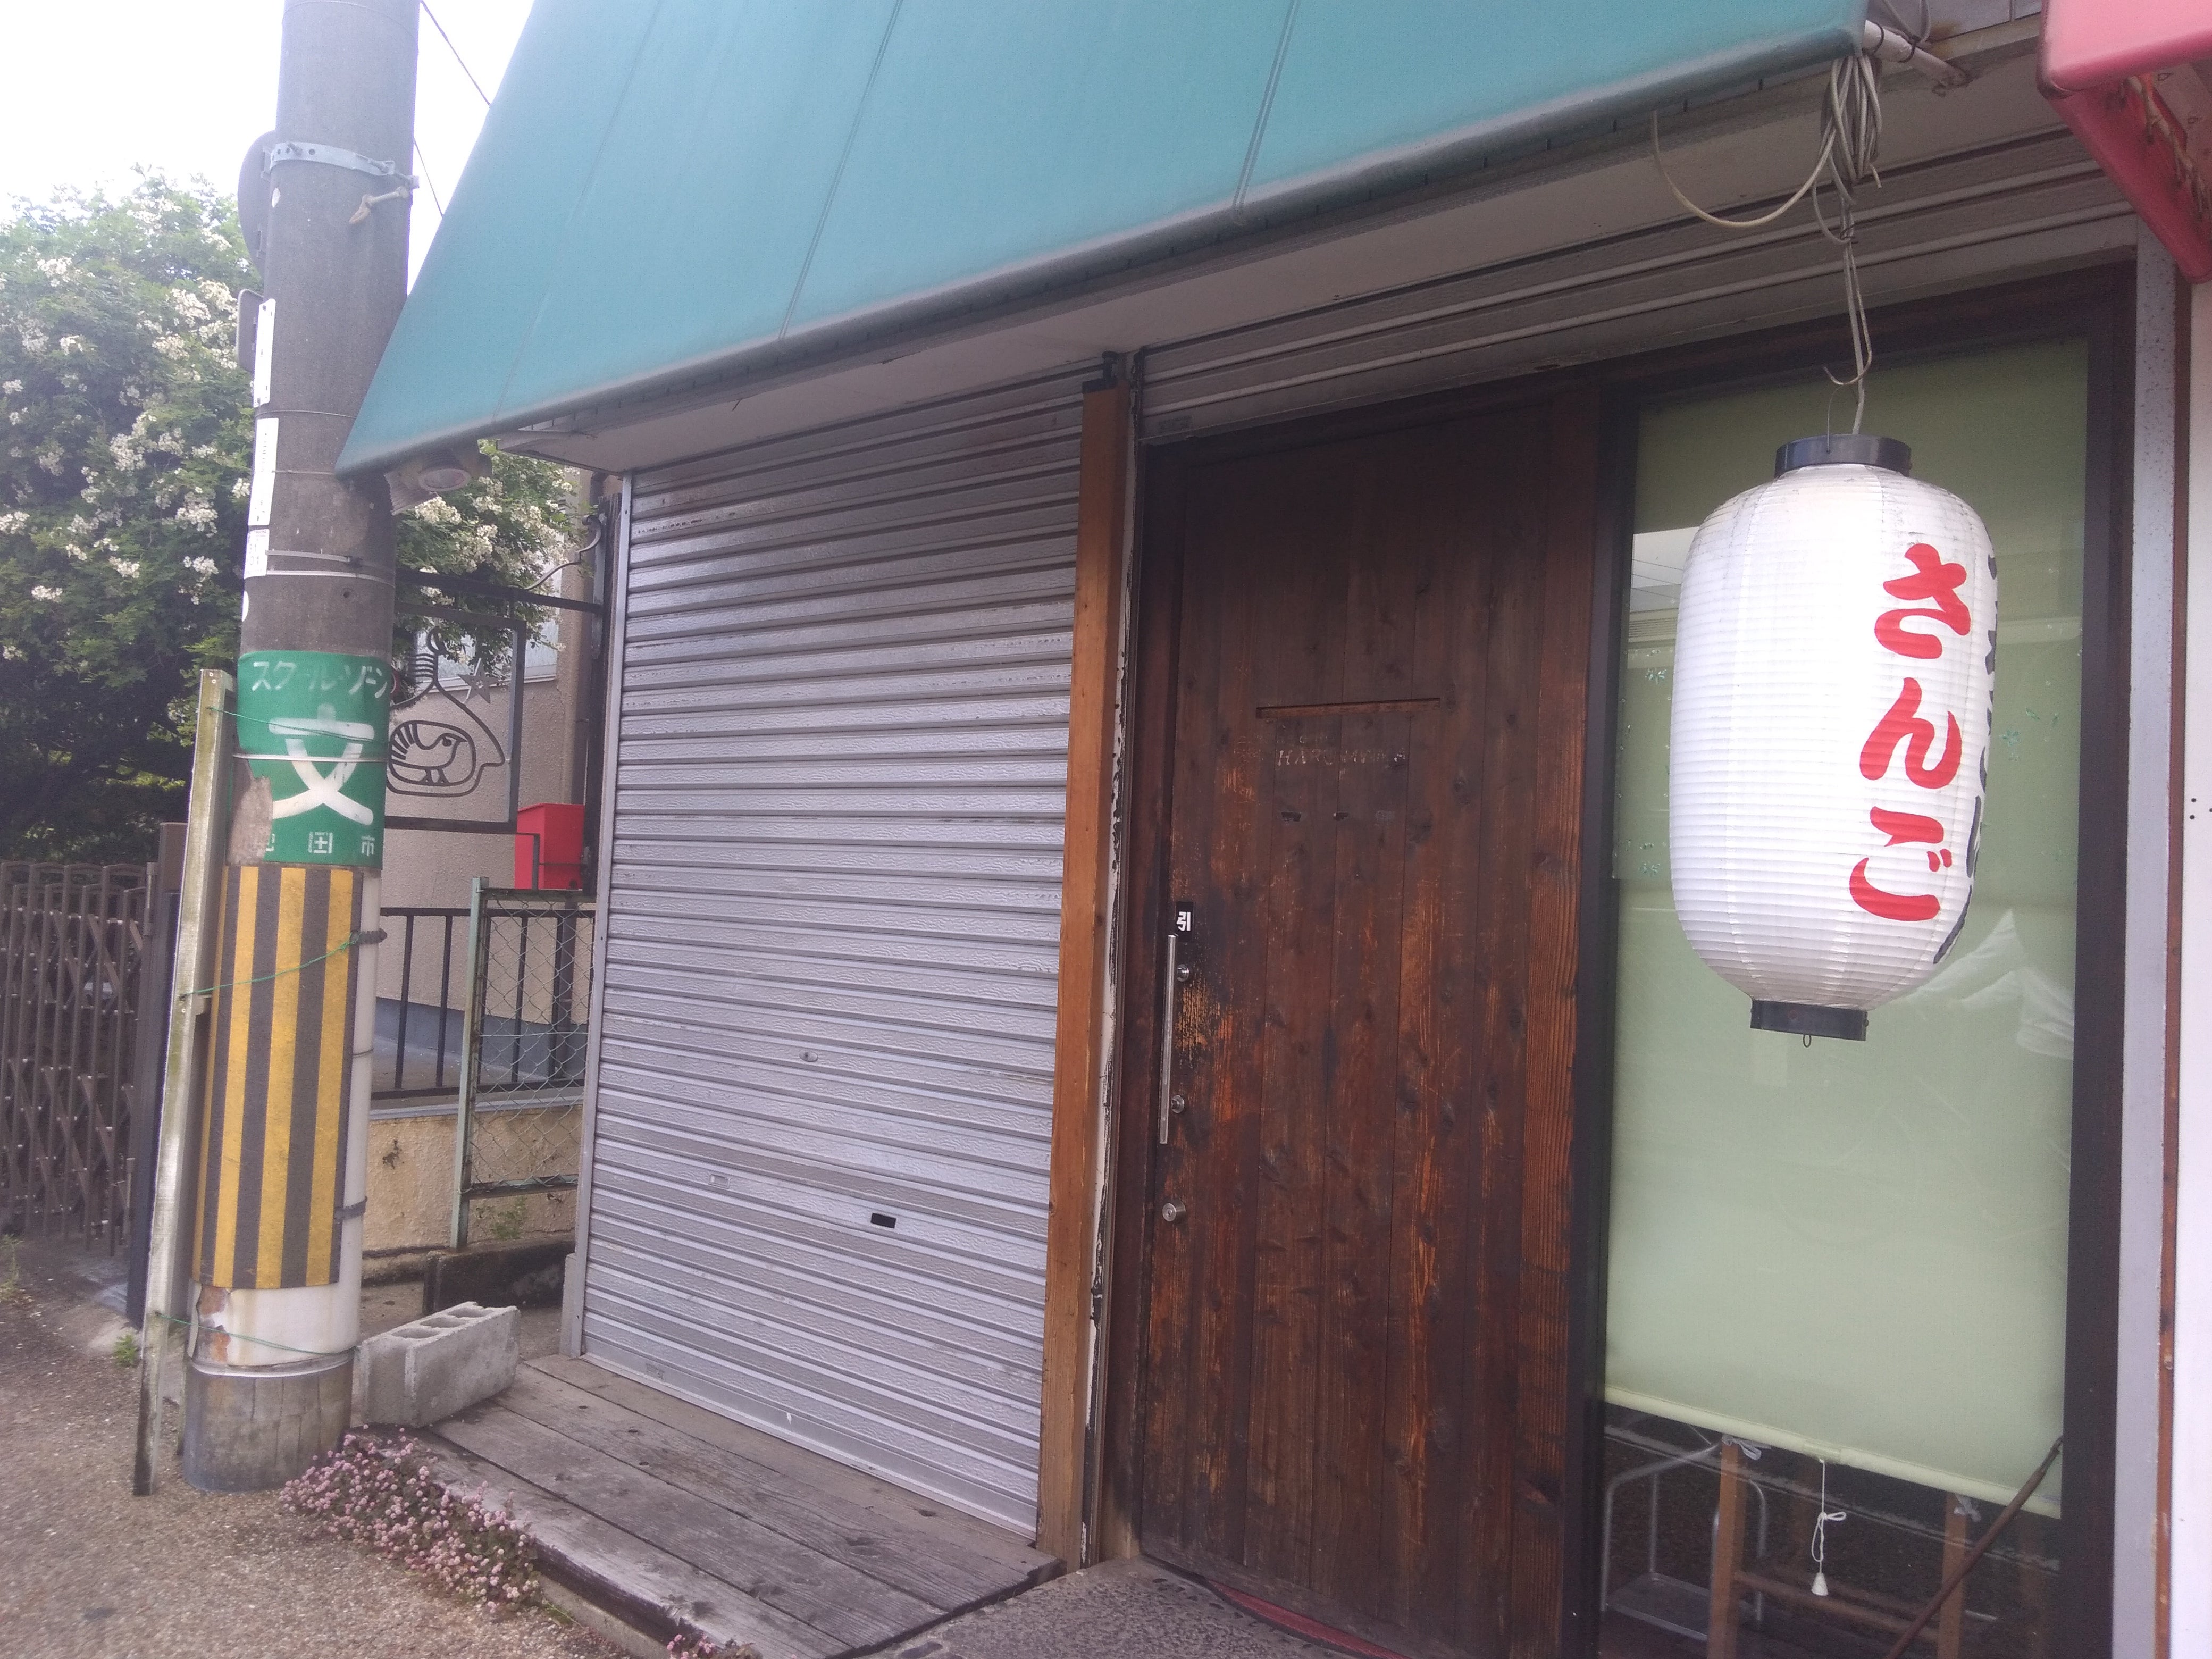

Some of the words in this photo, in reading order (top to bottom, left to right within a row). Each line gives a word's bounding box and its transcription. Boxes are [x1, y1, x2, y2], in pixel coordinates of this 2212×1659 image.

[269, 703, 375, 826] 文
[1849, 543, 1971, 921] さんご
